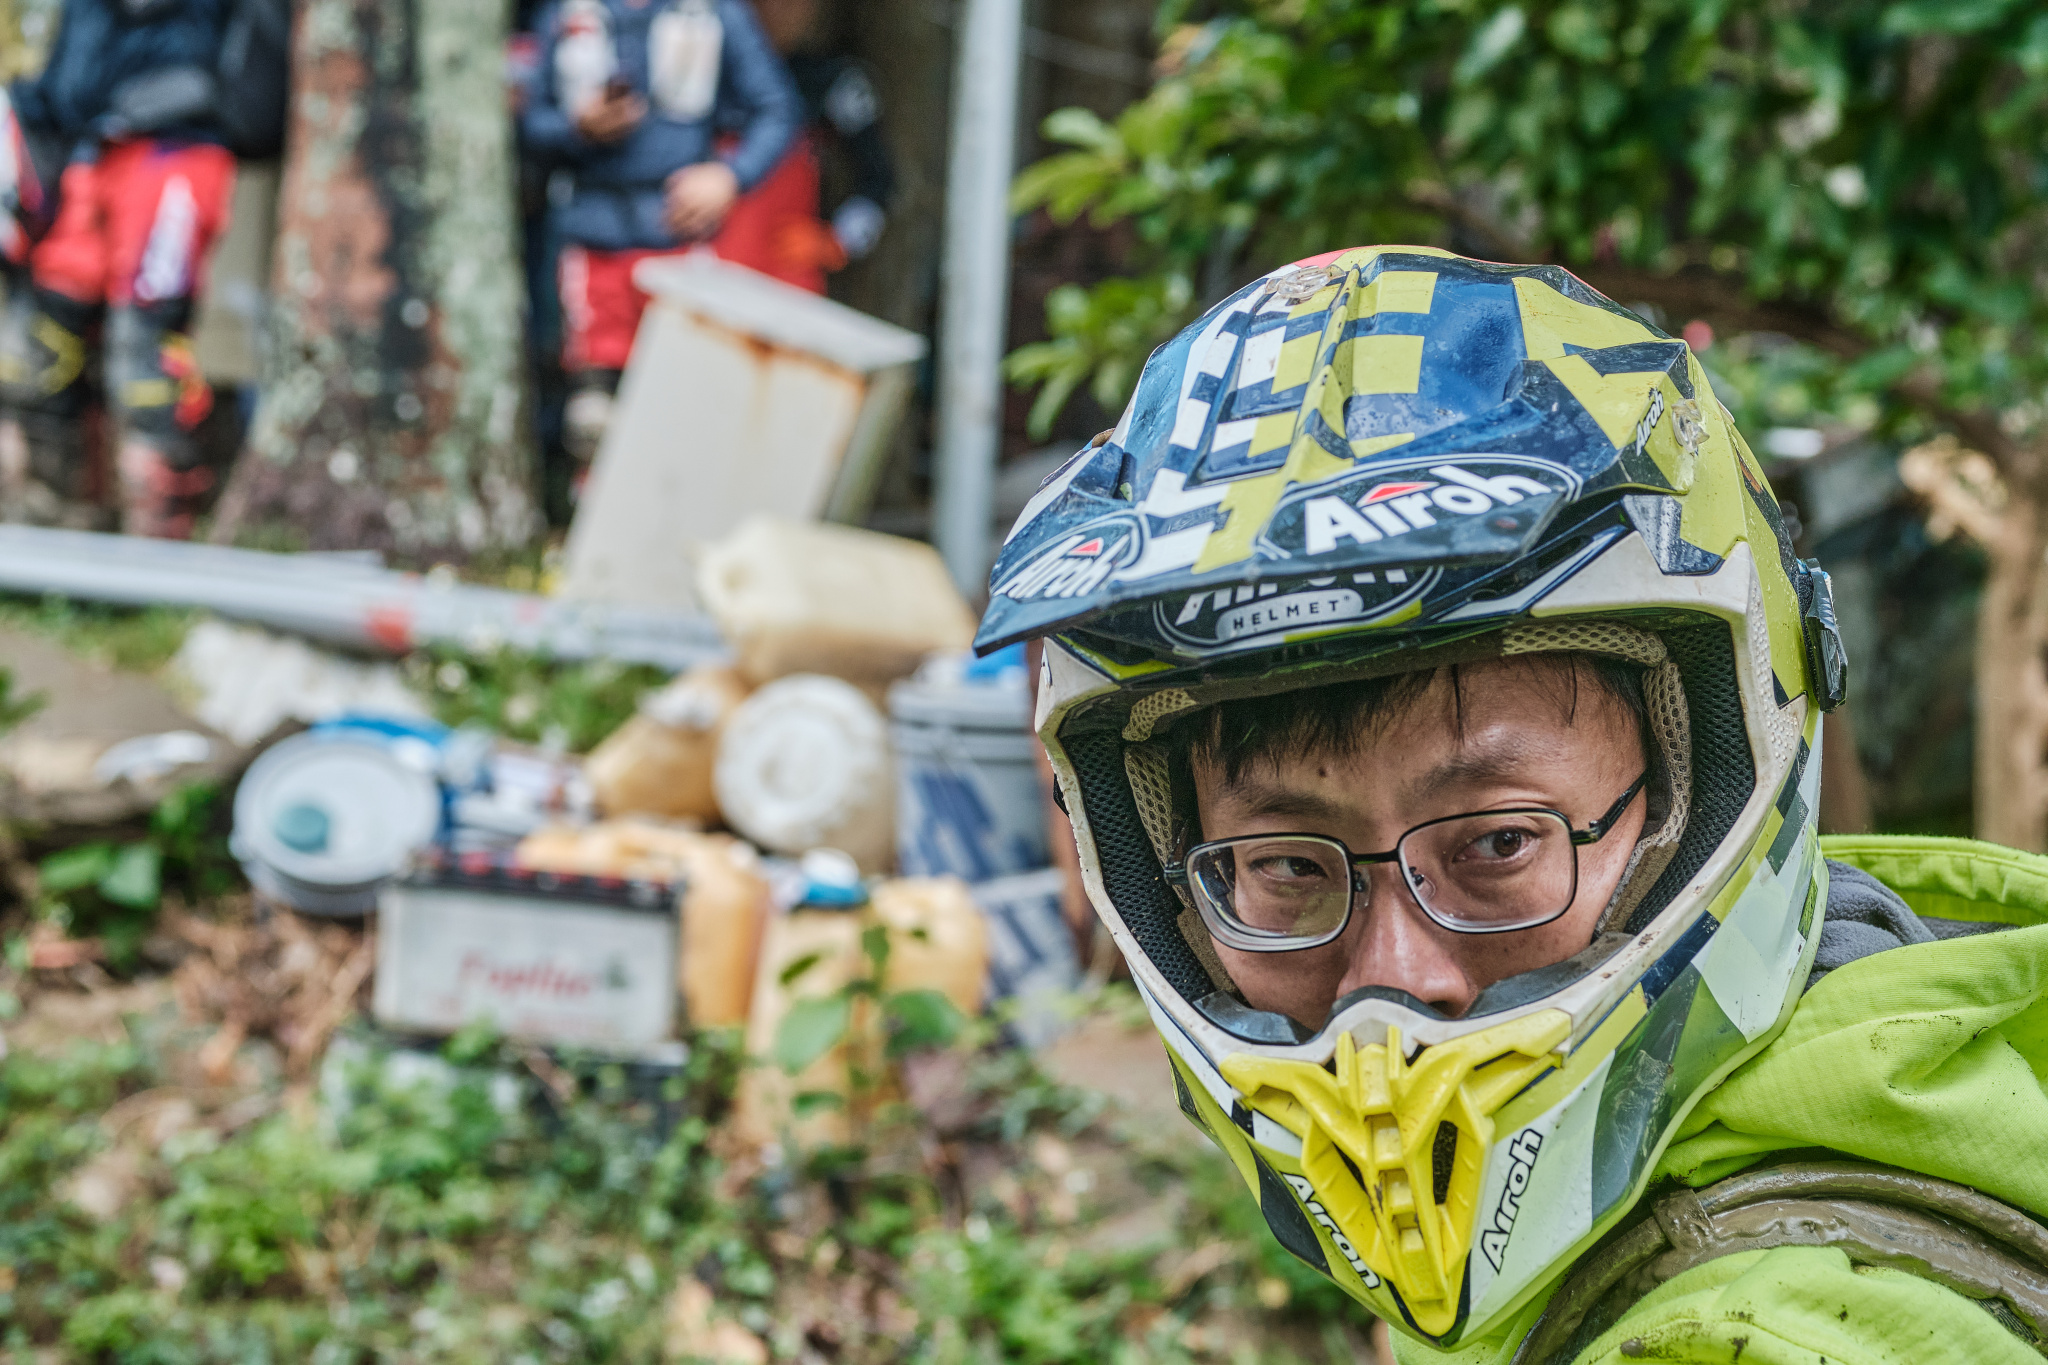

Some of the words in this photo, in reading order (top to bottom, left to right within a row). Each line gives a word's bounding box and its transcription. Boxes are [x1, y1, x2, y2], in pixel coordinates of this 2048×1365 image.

[1636, 387, 1664, 456] Airoh
[1305, 464, 1552, 556] Airoh
[992, 534, 1130, 599] Airoh
[1233, 599, 1341, 629] HELMET
[1481, 1128, 1543, 1275] Airoh
